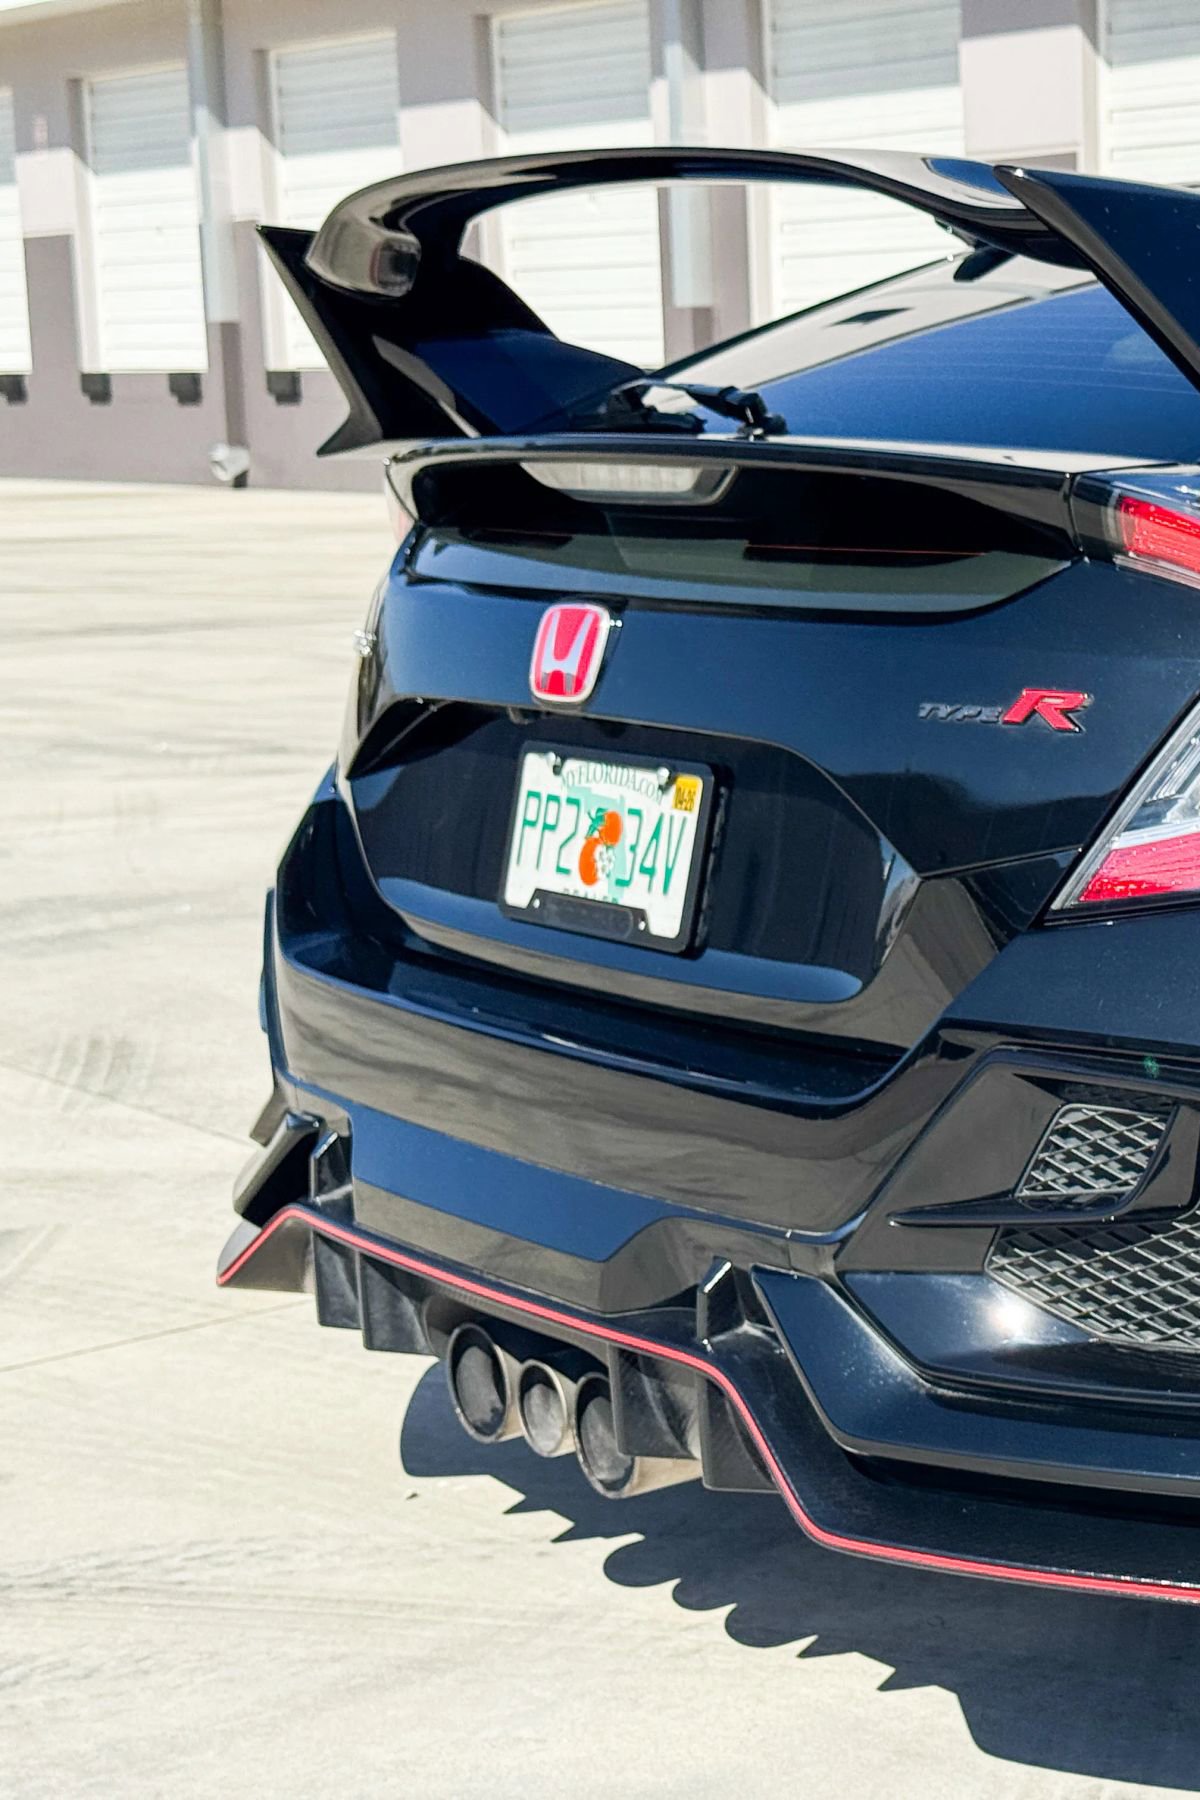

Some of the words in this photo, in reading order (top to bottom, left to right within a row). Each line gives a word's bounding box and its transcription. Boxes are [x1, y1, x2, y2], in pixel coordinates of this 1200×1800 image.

[919, 702, 1002, 723] TYPE
[1002, 688, 1091, 733] R
[515, 789, 581, 876] PP2
[615, 807, 688, 896] 34V
